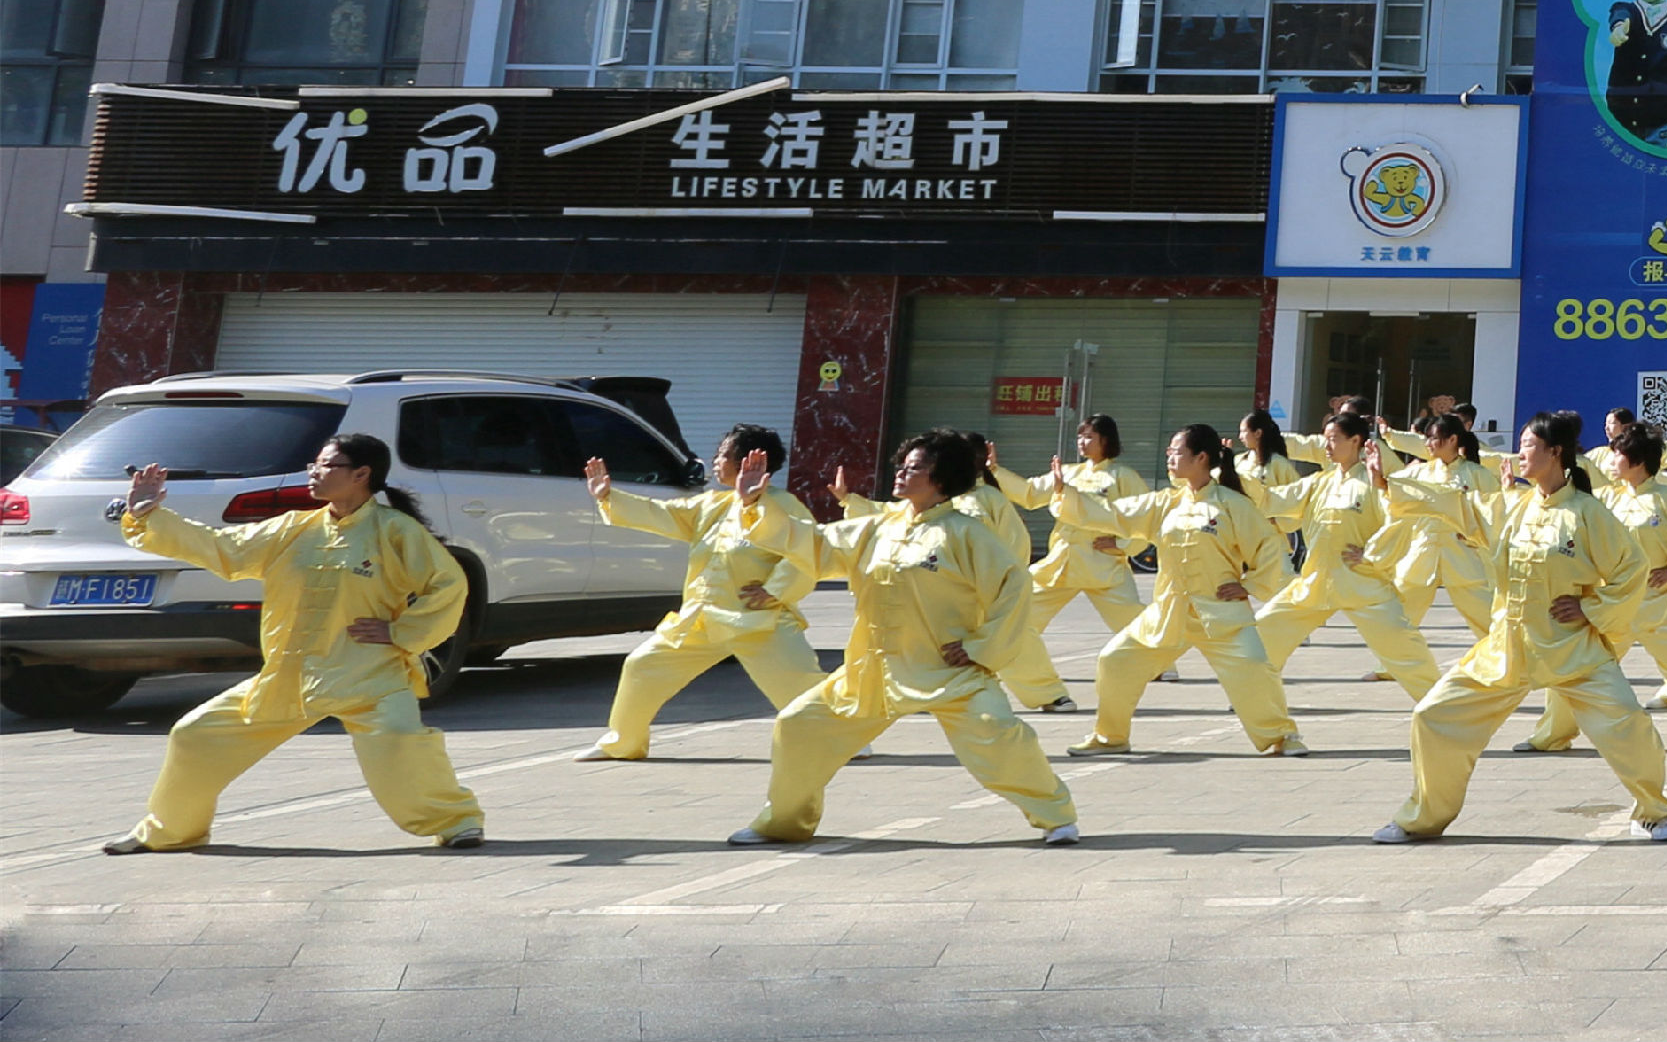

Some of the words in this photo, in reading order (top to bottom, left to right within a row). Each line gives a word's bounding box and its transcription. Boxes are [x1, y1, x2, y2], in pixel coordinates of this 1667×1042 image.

[272, 103, 498, 193] 优品
[670, 110, 1009, 171] 生活超市
[672, 176, 844, 199] LIFESTYLE
[862, 178, 998, 201] MARKET
